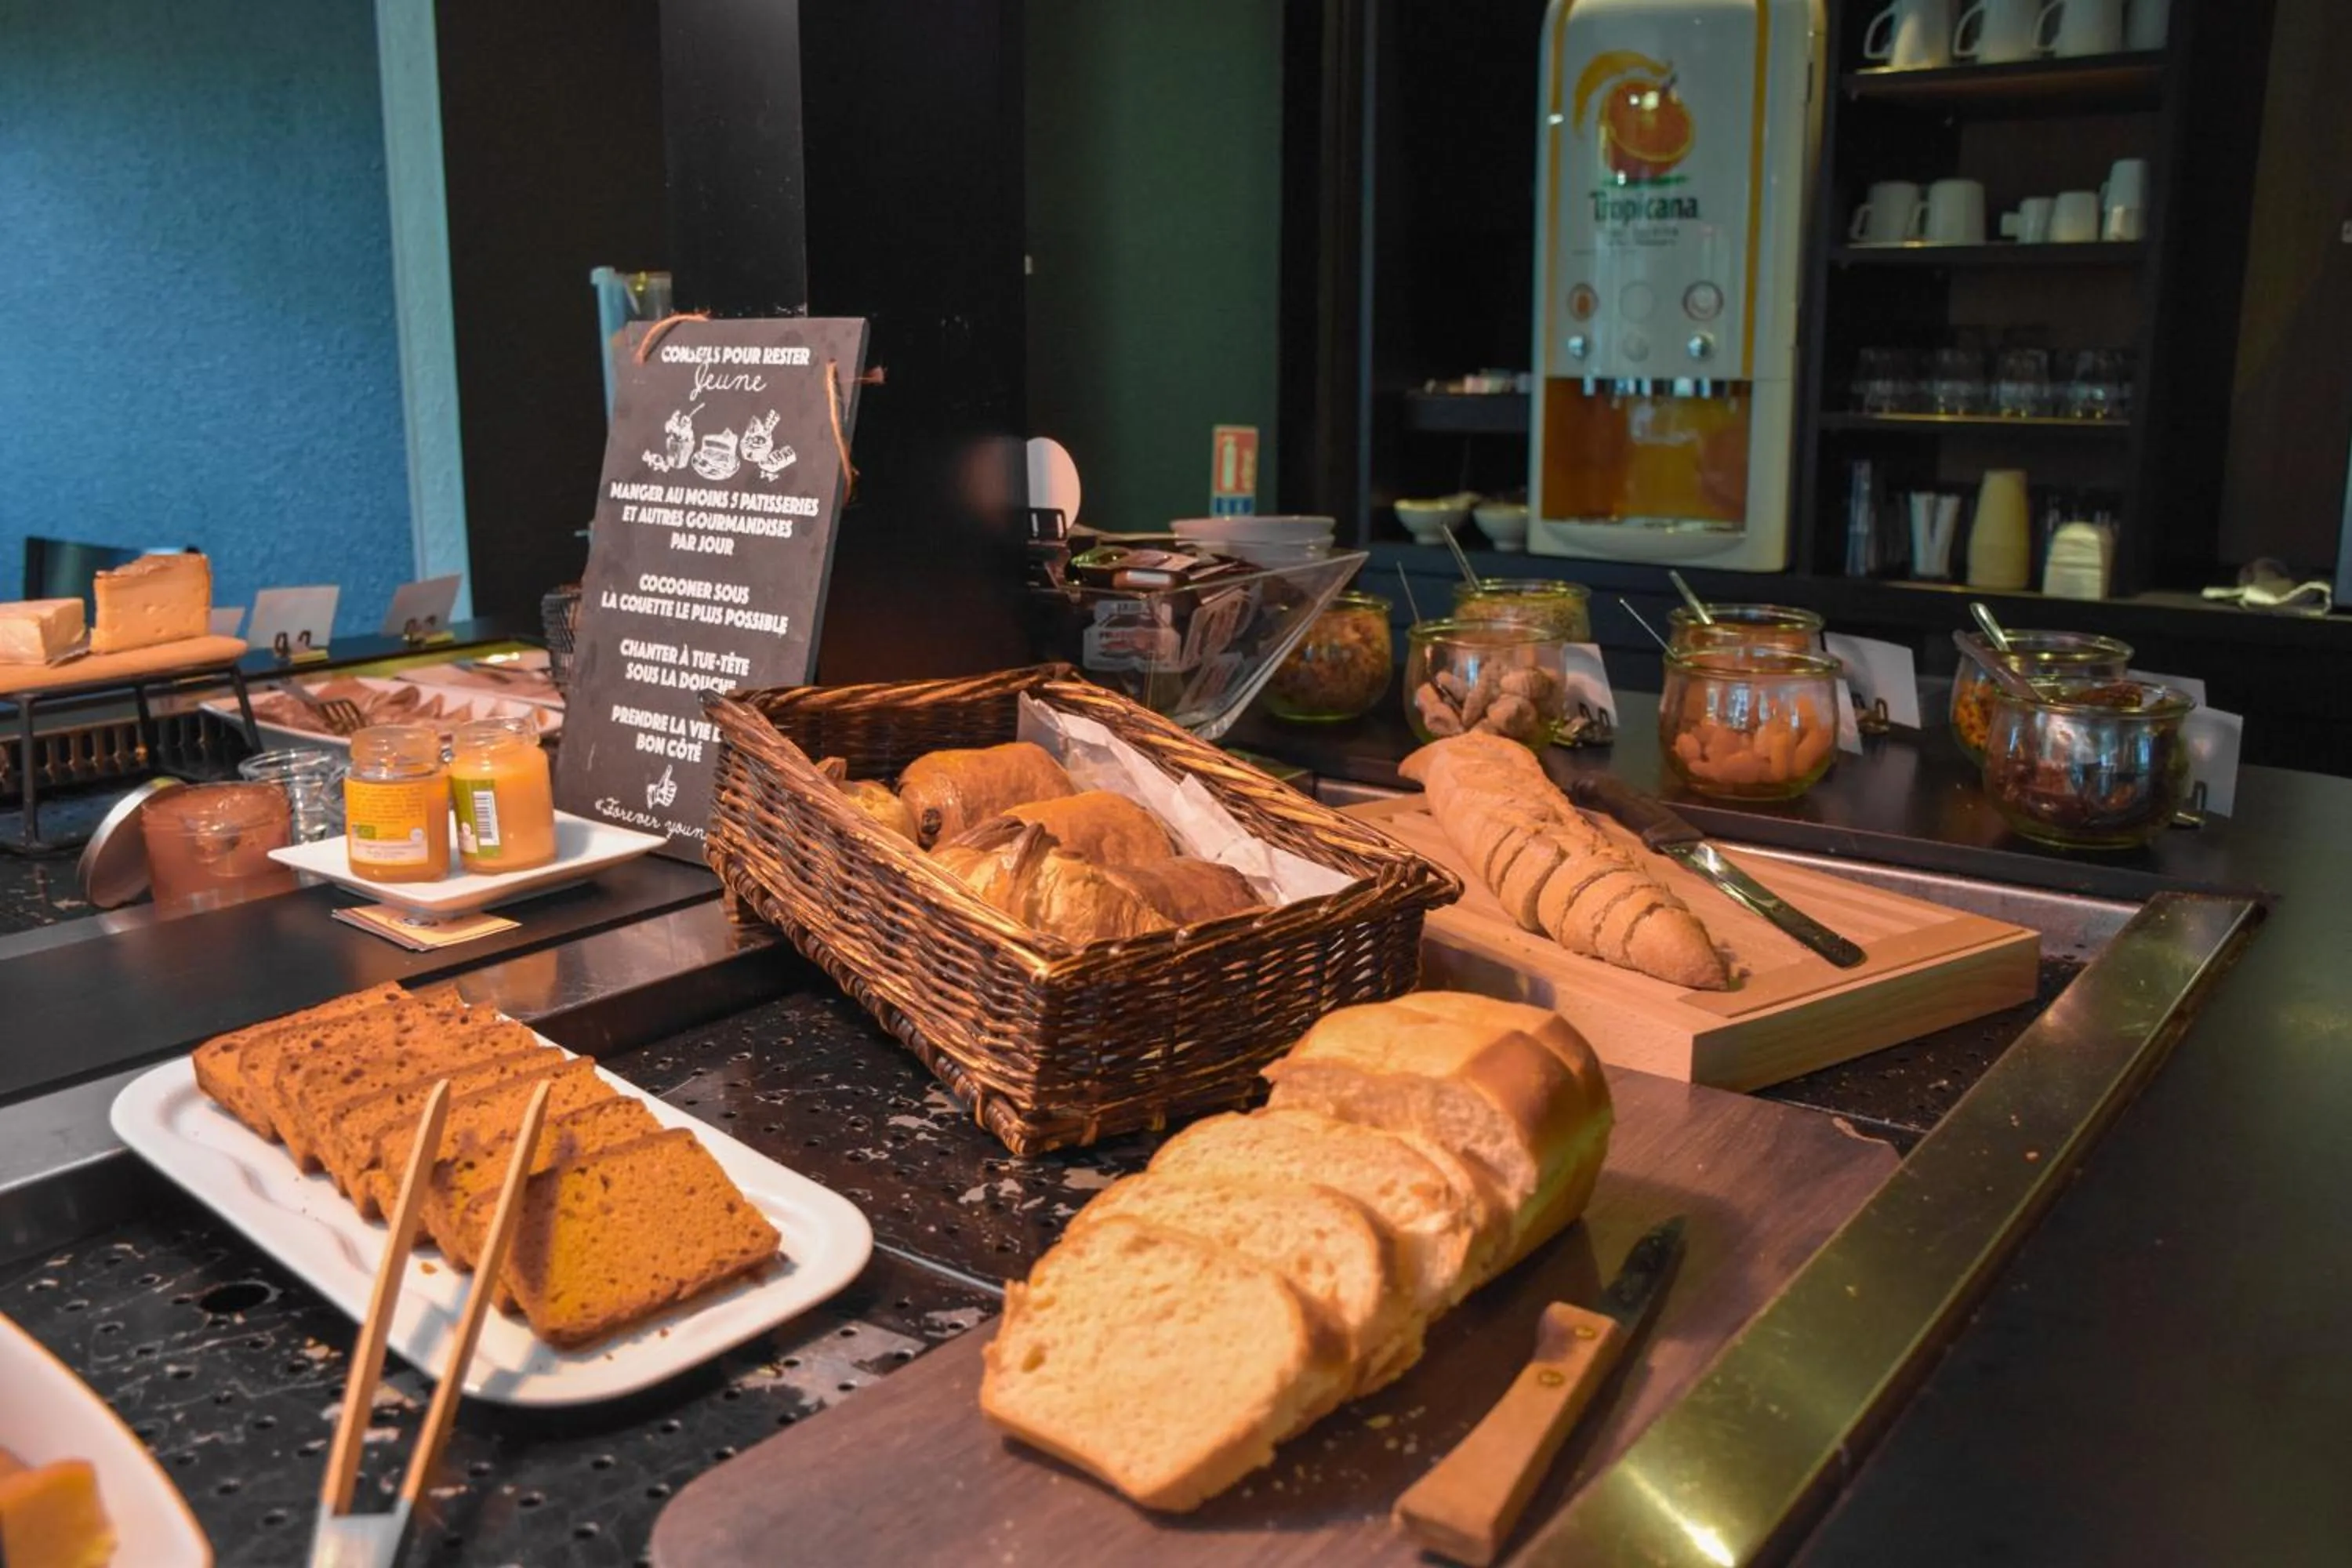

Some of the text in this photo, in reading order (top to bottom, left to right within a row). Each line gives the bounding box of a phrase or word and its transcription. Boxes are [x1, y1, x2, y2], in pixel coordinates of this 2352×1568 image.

[661, 345, 811, 365] CONSEILS POUR RESTER
[689, 359, 768, 401] Jeune
[610, 482, 819, 516] MANGER AU MOINS 5 PATISSERIES
[622, 506, 793, 538] ET AUTRES GOURMANDISES
[670, 532, 735, 556] PAR JOUR
[639, 573, 750, 604] COCOONER SOUS
[601, 590, 789, 634] LA COUETTE LE PLUS POSSIBLE
[619, 639, 678, 664] CHANTER
[678, 643, 689, 666] À
[625, 662, 659, 684] SOUS
[660, 667, 677, 688] LA
[611, 705, 669, 731] PRENDRE
[669, 716, 686, 735] LA
[689, 719, 713, 742] VIE
[635, 732, 703, 763] BON CÔTÉ
[664, 820, 707, 840] youn
